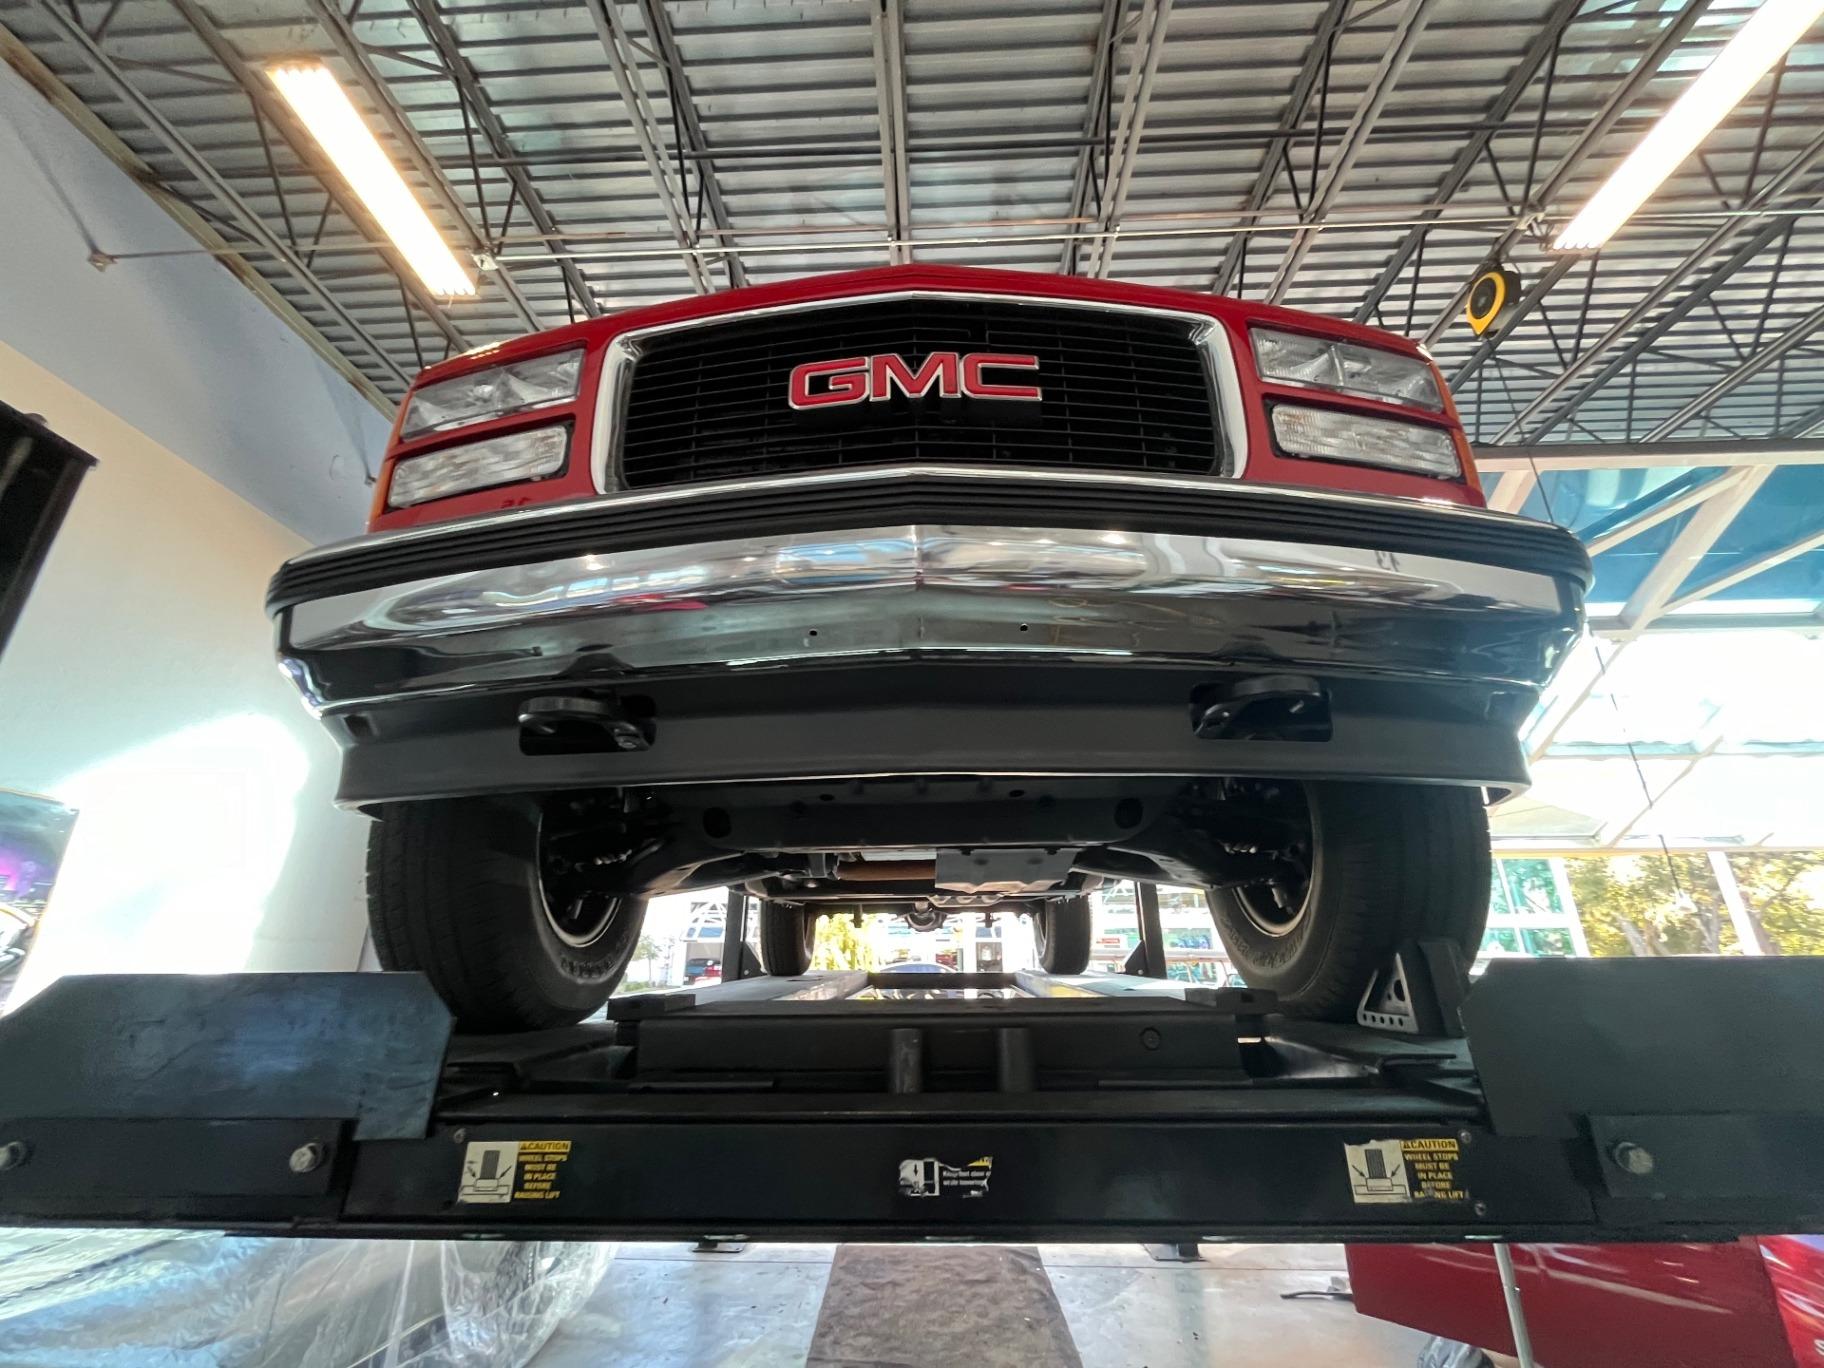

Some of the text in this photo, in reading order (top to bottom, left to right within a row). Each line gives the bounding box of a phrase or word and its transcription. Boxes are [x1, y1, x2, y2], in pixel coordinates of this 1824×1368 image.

[788, 351, 1043, 411] GMC
[527, 1142, 569, 1150] CAUTION
[1410, 1140, 1456, 1149] CAUTION
[1403, 1153, 1459, 1161] WHEEL STOPS
[1414, 1162, 1450, 1170] MUST BE
[1417, 1171, 1453, 1180] IN PLACE
[1421, 1181, 1451, 1189] BEFORE
[545, 1190, 561, 1199] LIFT
[1448, 1190, 1464, 1199] LIFT
